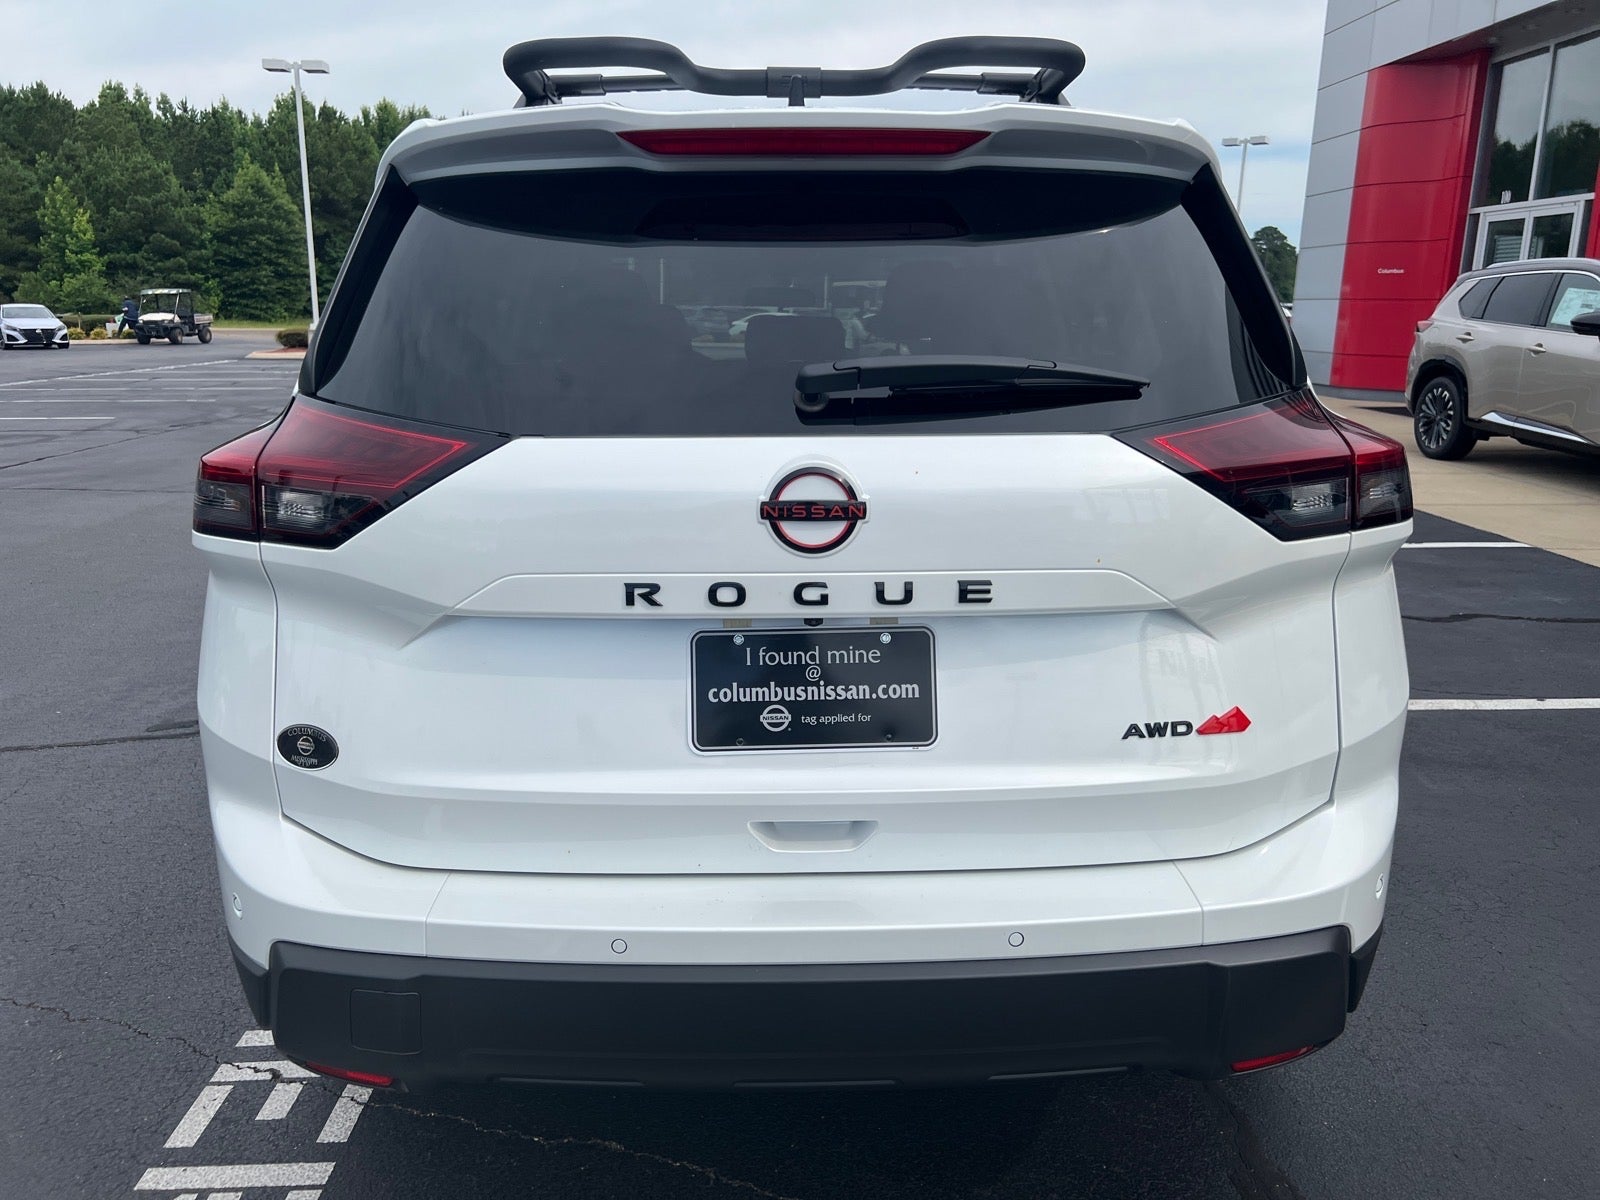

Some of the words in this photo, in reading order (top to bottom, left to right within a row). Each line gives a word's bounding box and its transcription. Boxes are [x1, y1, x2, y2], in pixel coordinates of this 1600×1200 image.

[762, 504, 865, 519] NISSAN
[623, 580, 993, 607] ROGUE
[746, 648, 751, 666] I
[759, 646, 820, 666] found
[827, 646, 881, 664] mine
[805, 665, 821, 681] @
[708, 681, 920, 703] columbusnissan.com
[801, 715, 817, 725] tag
[819, 713, 855, 724] applied
[858, 713, 872, 722] for
[1122, 720, 1194, 740] AWD
